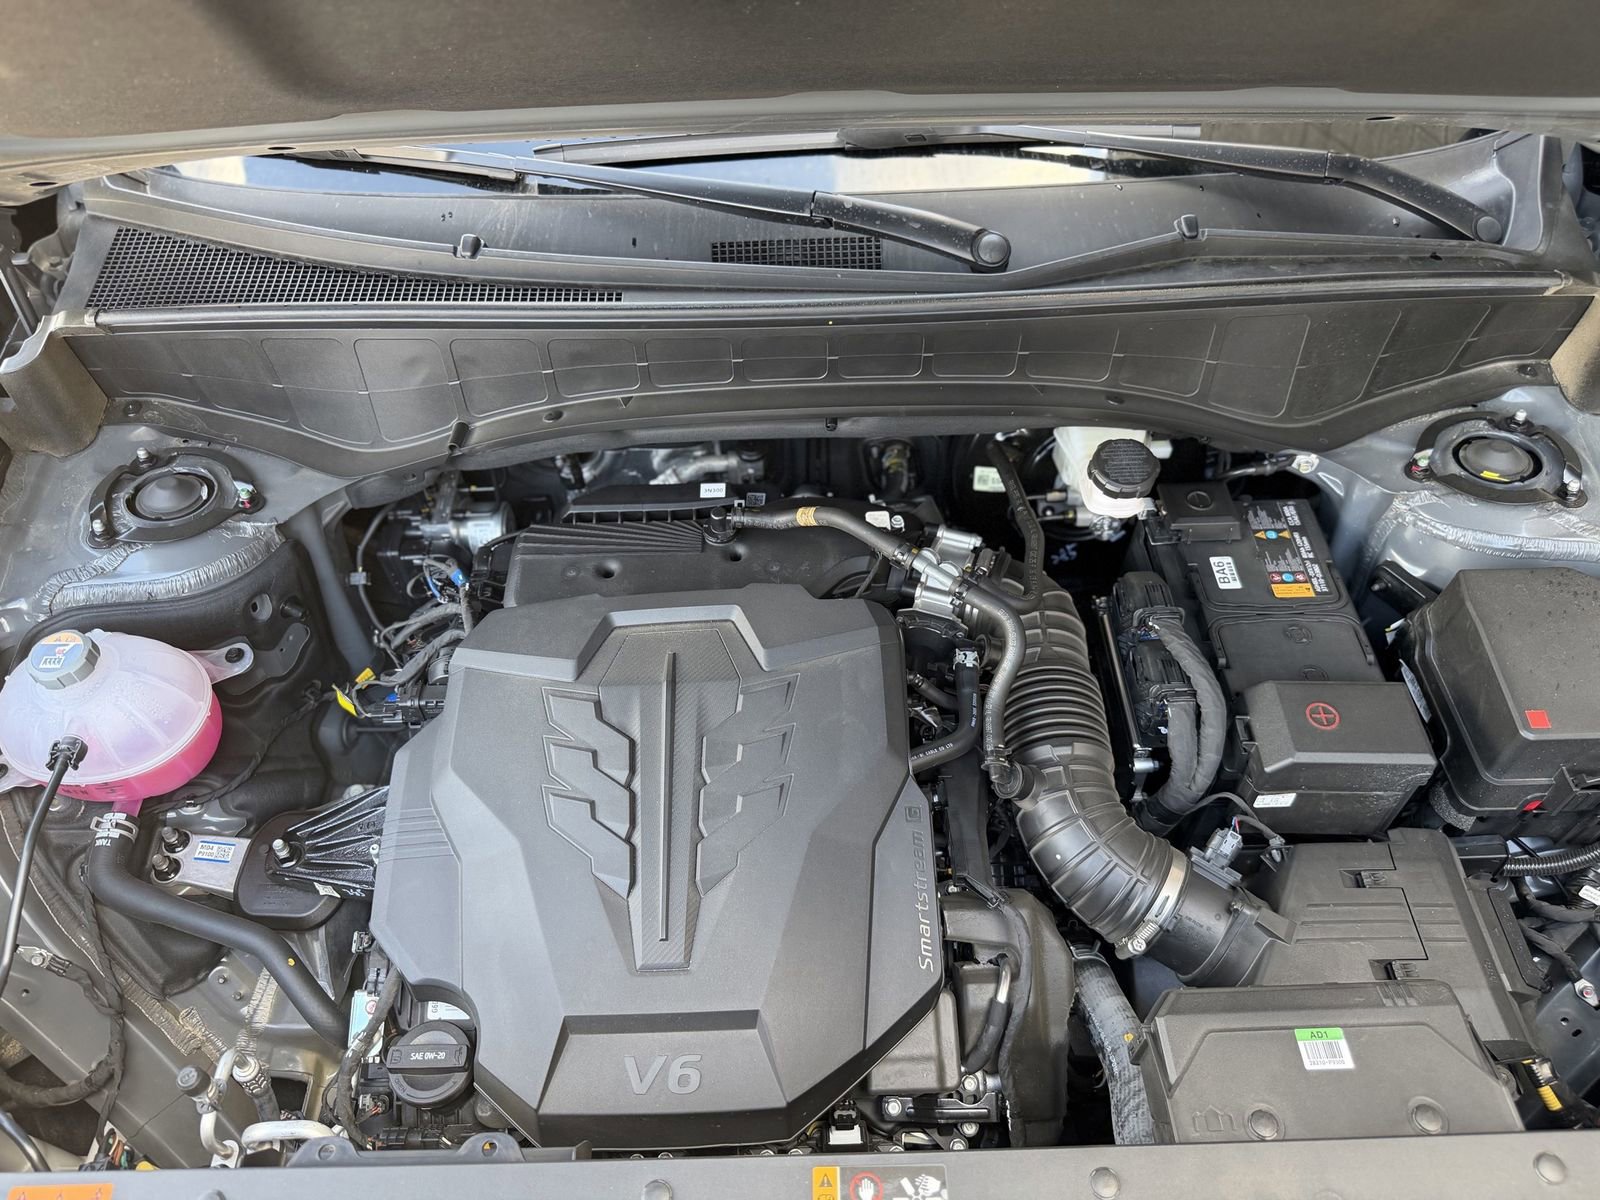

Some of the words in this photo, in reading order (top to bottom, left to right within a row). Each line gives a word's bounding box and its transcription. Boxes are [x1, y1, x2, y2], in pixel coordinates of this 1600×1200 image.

[1212, 561, 1231, 584] BA6
[912, 831, 934, 973] Smartstream
[1310, 1030, 1329, 1039] AD1
[410, 1052, 423, 1060] SAE
[424, 1051, 446, 1060] 0W-20
[623, 1053, 703, 1096] V6
